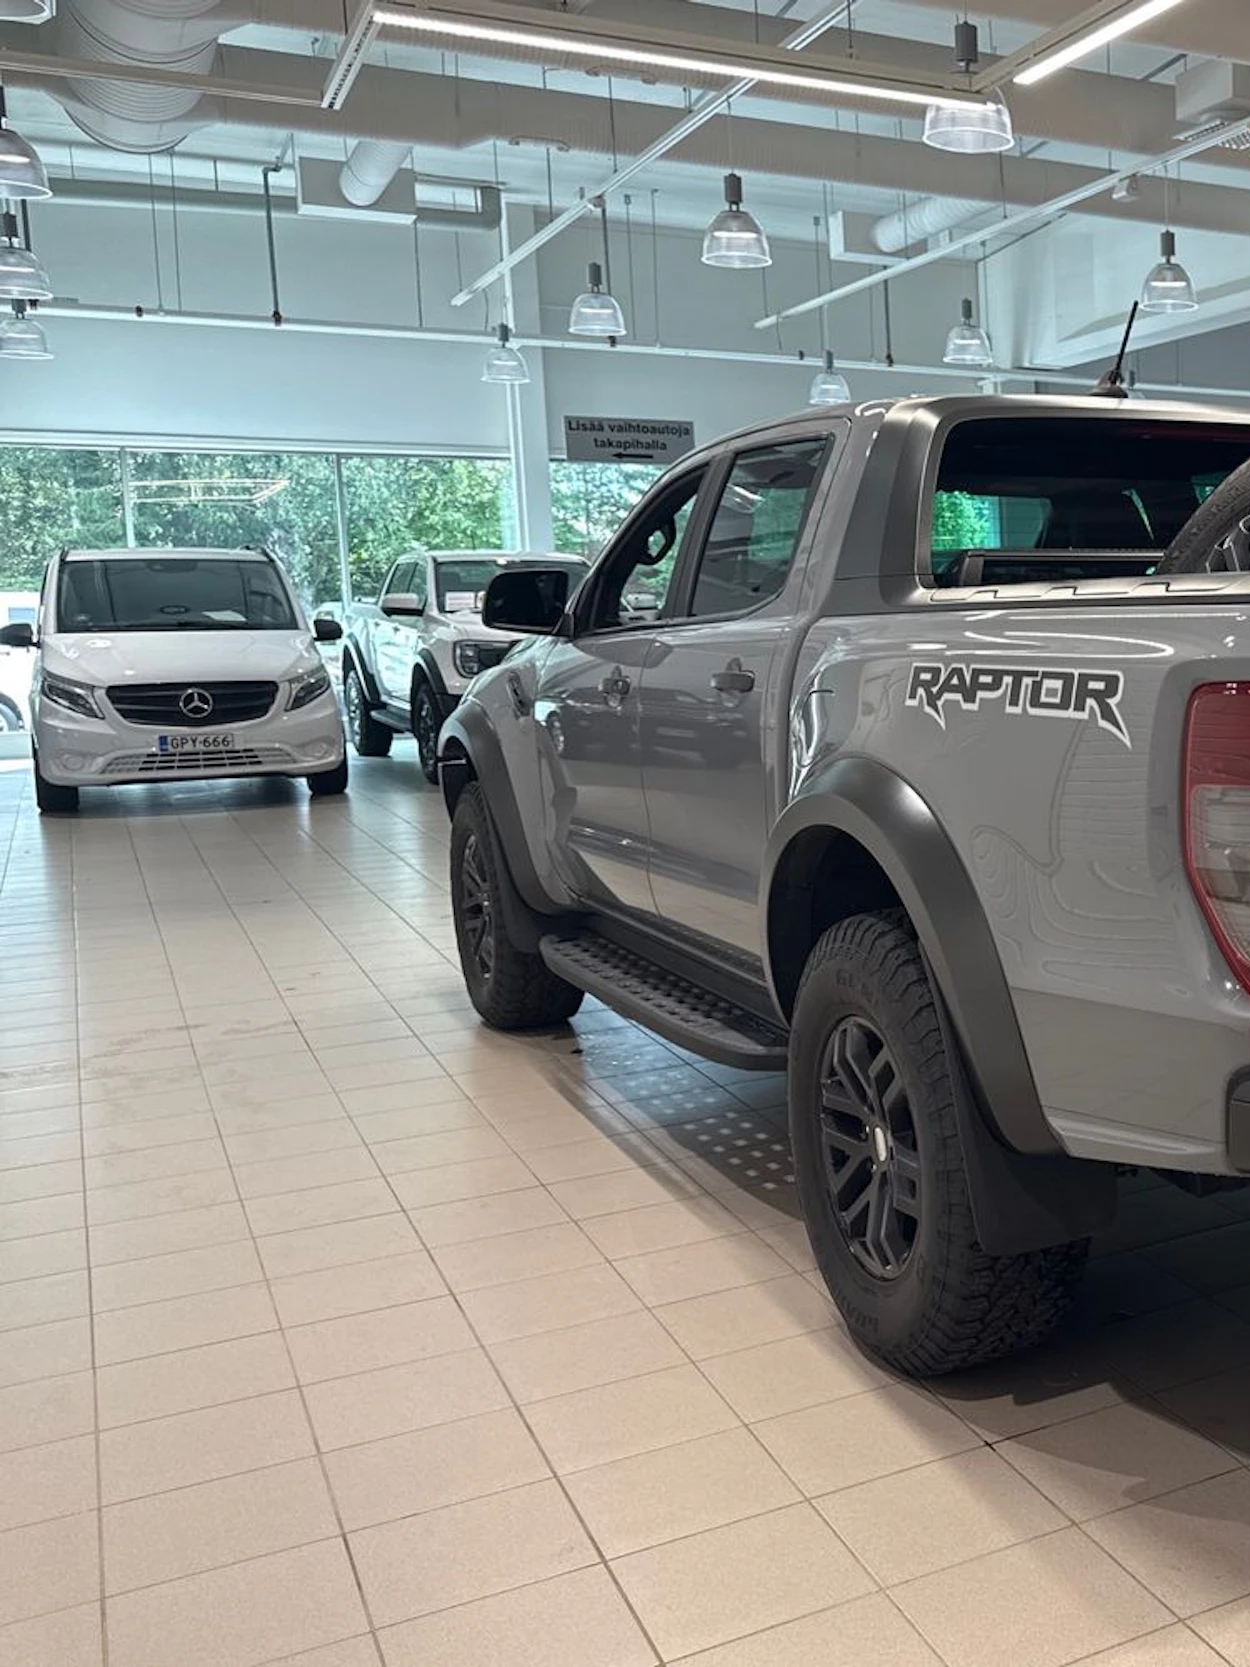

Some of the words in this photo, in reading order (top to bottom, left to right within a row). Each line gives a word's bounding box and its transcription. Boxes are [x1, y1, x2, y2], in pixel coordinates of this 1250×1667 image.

[567, 420, 604, 433] Lisää
[608, 422, 690, 438] vaihtoautoja
[593, 438, 668, 451] takapihalla
[905, 663, 1132, 749] RAPTOR
[170, 734, 231, 750] GPY-666
